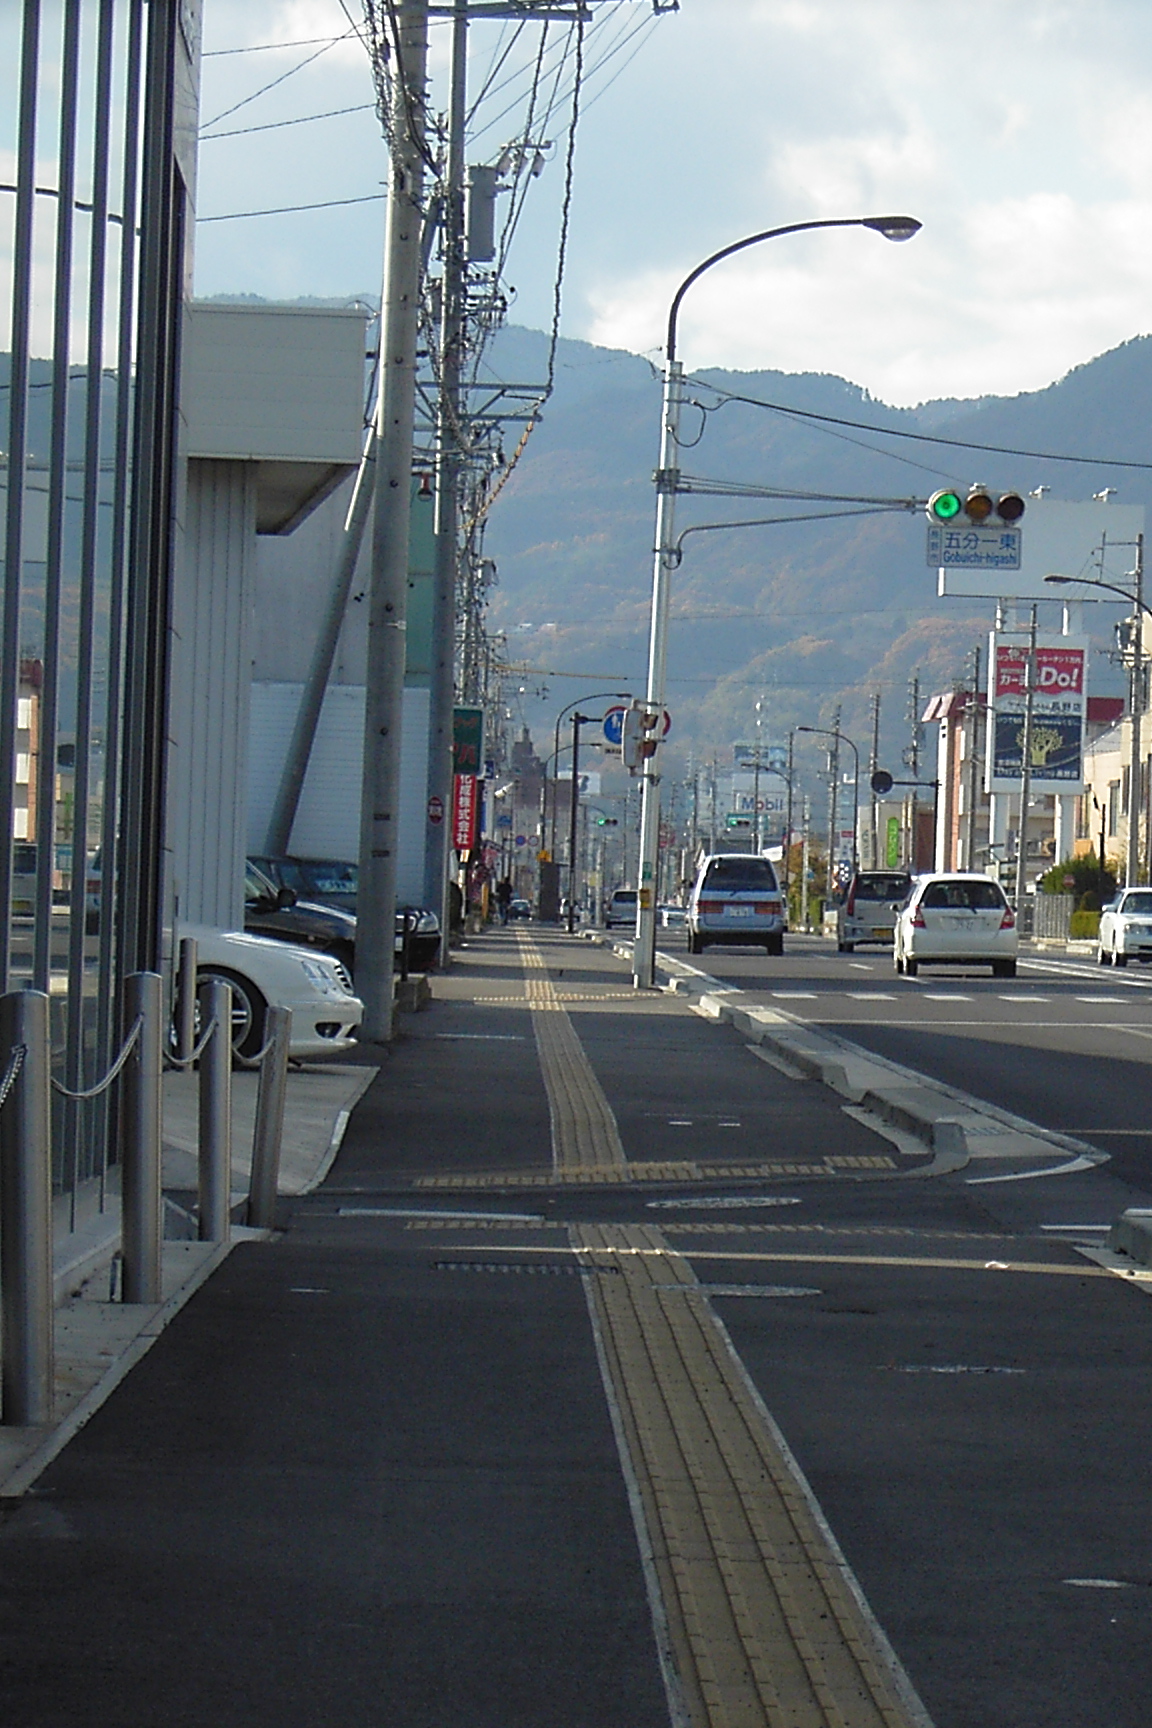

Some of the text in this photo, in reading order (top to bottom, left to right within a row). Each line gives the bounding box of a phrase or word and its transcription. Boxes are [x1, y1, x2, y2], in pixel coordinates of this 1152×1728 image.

[944, 532, 1017, 551] 五分一東
[943, 550, 1018, 566] Gobuichi-higashi
[1040, 667, 1079, 688] Do!
[741, 797, 783, 811] Mobil
